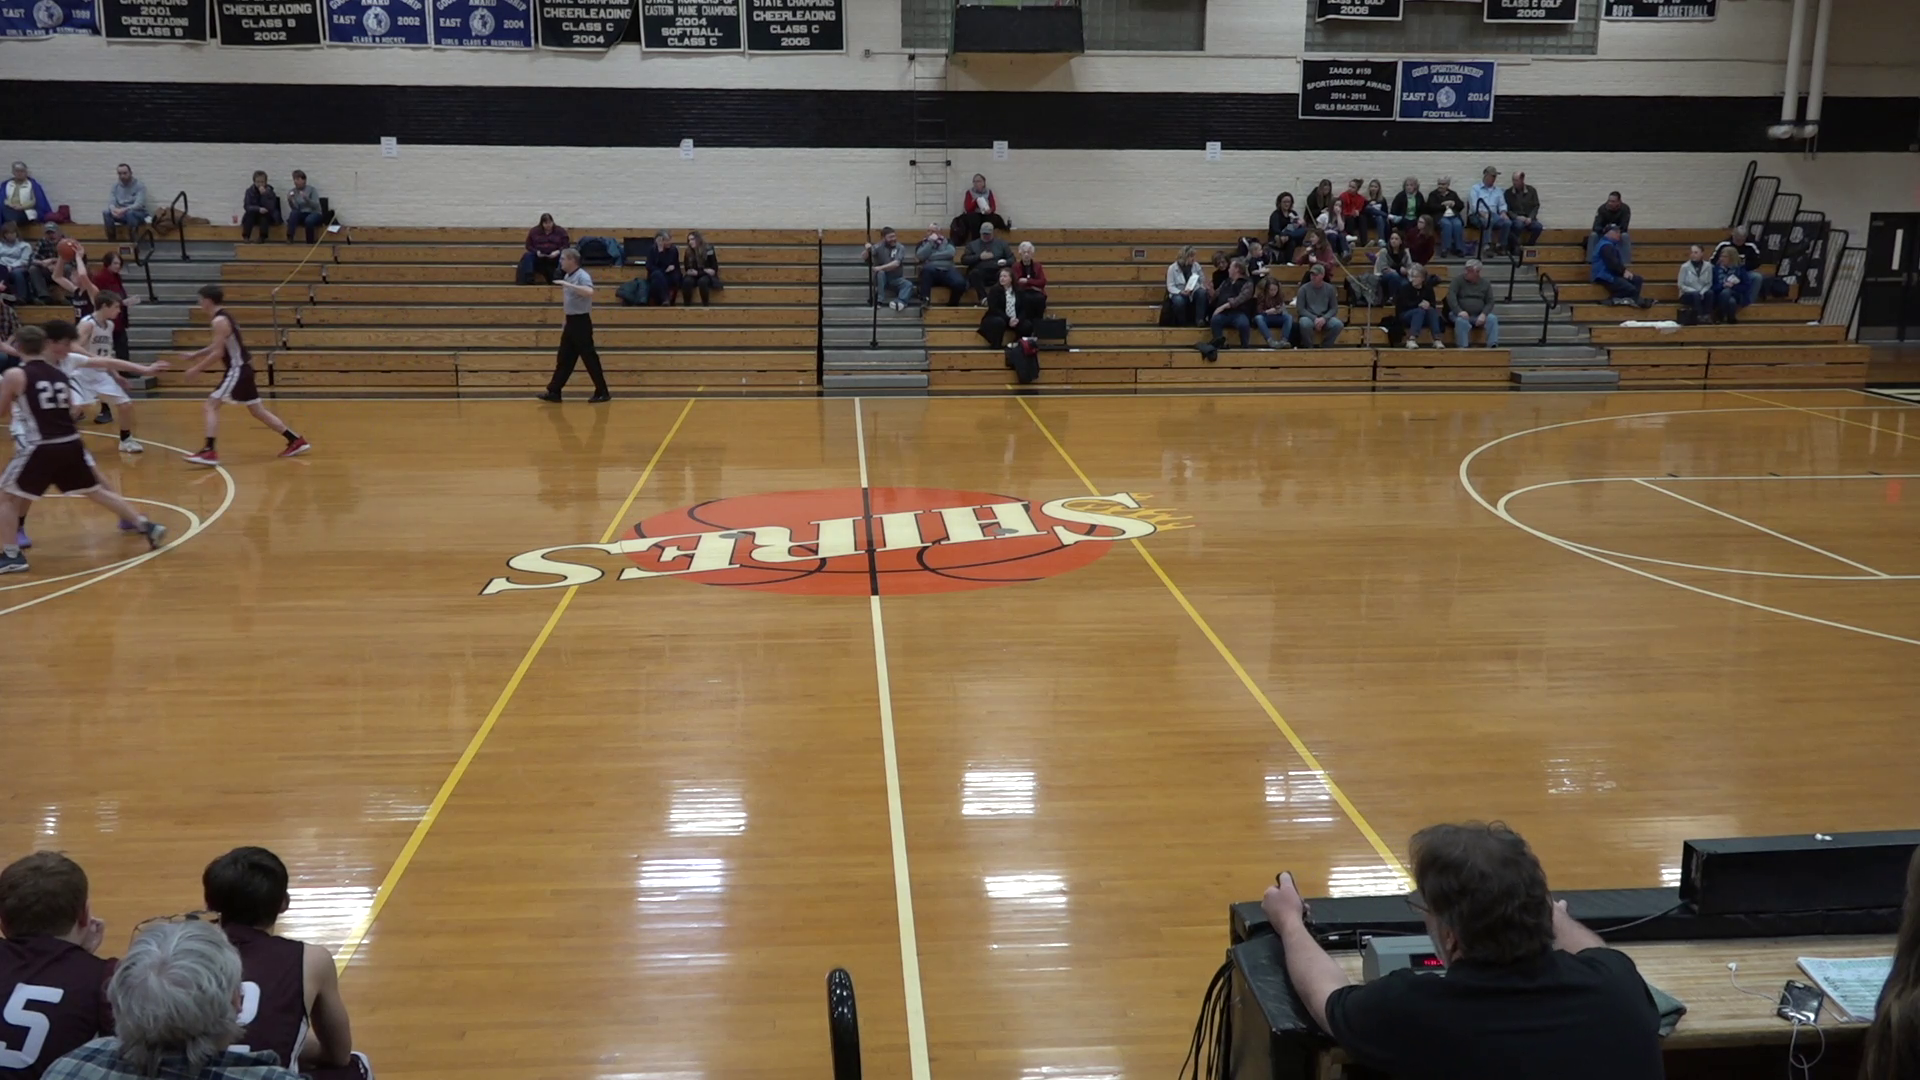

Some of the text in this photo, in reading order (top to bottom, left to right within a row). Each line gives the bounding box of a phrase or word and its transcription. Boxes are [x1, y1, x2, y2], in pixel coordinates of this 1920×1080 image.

[1540, 0, 1562, 8] GOLF
[2, 8, 25, 18] EAST
[140, 6, 171, 16] 2001
[222, 3, 312, 16] CHEERLEADING
[543, 7, 632, 20] CHEERLEADING
[644, 5, 738, 17] EASTERN MAINE CHAMPIONS
[1612, 4, 1709, 17] BOYS BASKETBALL
[333, 15, 421, 26] EAST 2002
[753, 10, 836, 21] CHEERLEADING
[121, 16, 189, 27] CHEERLEADING
[241, 18, 283, 28] CLASS
[439, 18, 524, 29] EAST 2004
[675, 17, 708, 27] 2004
[129, 26, 171, 37] CLASS
[562, 22, 615, 32] CLASS C
[661, 27, 724, 37] SOFTBALL
[769, 24, 820, 34] CLASS C
[253, 31, 287, 41] 2002
[572, 35, 605, 44] 2004
[667, 37, 718, 47] CLASS C
[1430, 64, 1484, 78] SPORTSMANSHIP
[1431, 75, 1463, 83] AWARD
[1306, 79, 1392, 91] SPORTSMANSHIP AWARD
[1402, 92, 1426, 101] EAST
[1467, 92, 1490, 101] 2014
[1314, 103, 1335, 111] GIRLS
[35, 380, 70, 410] 22
[478, 492, 1156, 596] SHIRES
[0, 982, 65, 1069] 5
